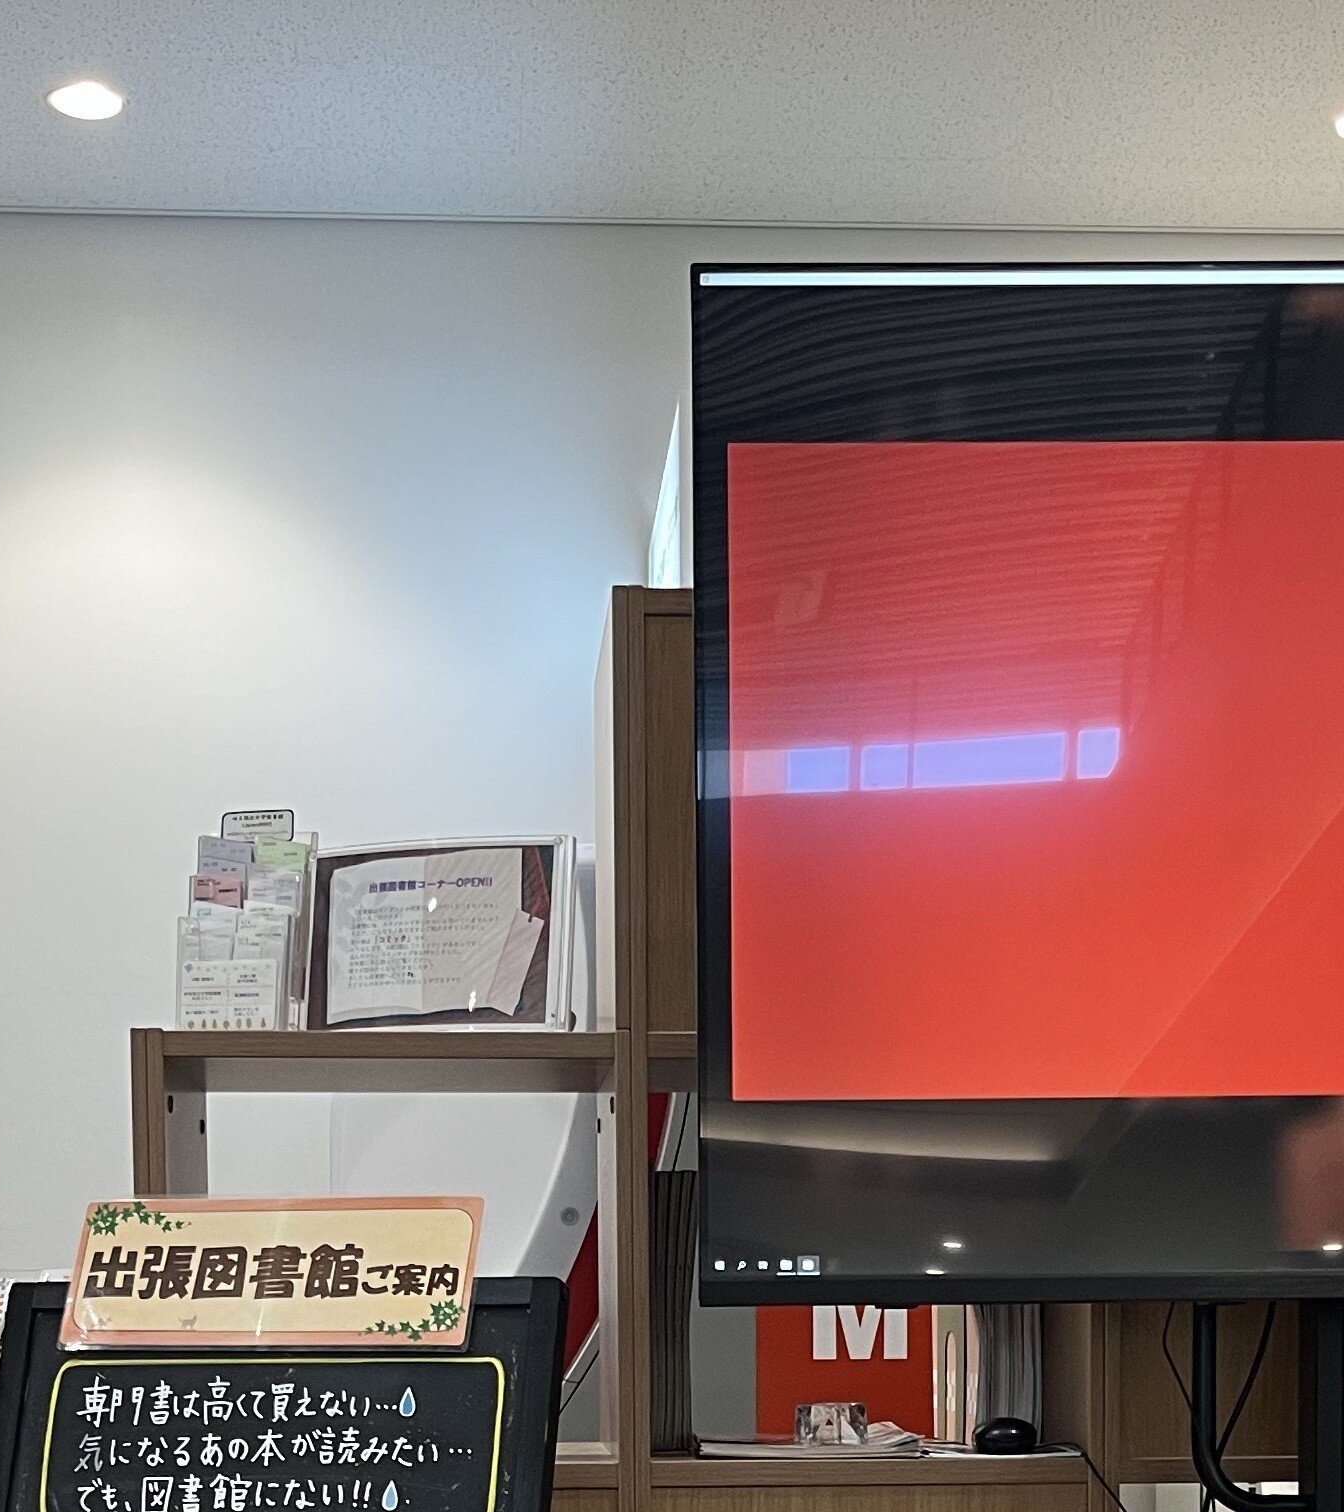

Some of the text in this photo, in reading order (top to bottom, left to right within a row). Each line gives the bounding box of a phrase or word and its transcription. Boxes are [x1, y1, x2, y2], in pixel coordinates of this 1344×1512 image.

[83, 1243, 460, 1300] 出張図書館ご案内
[813, 1305, 908, 1360] M
